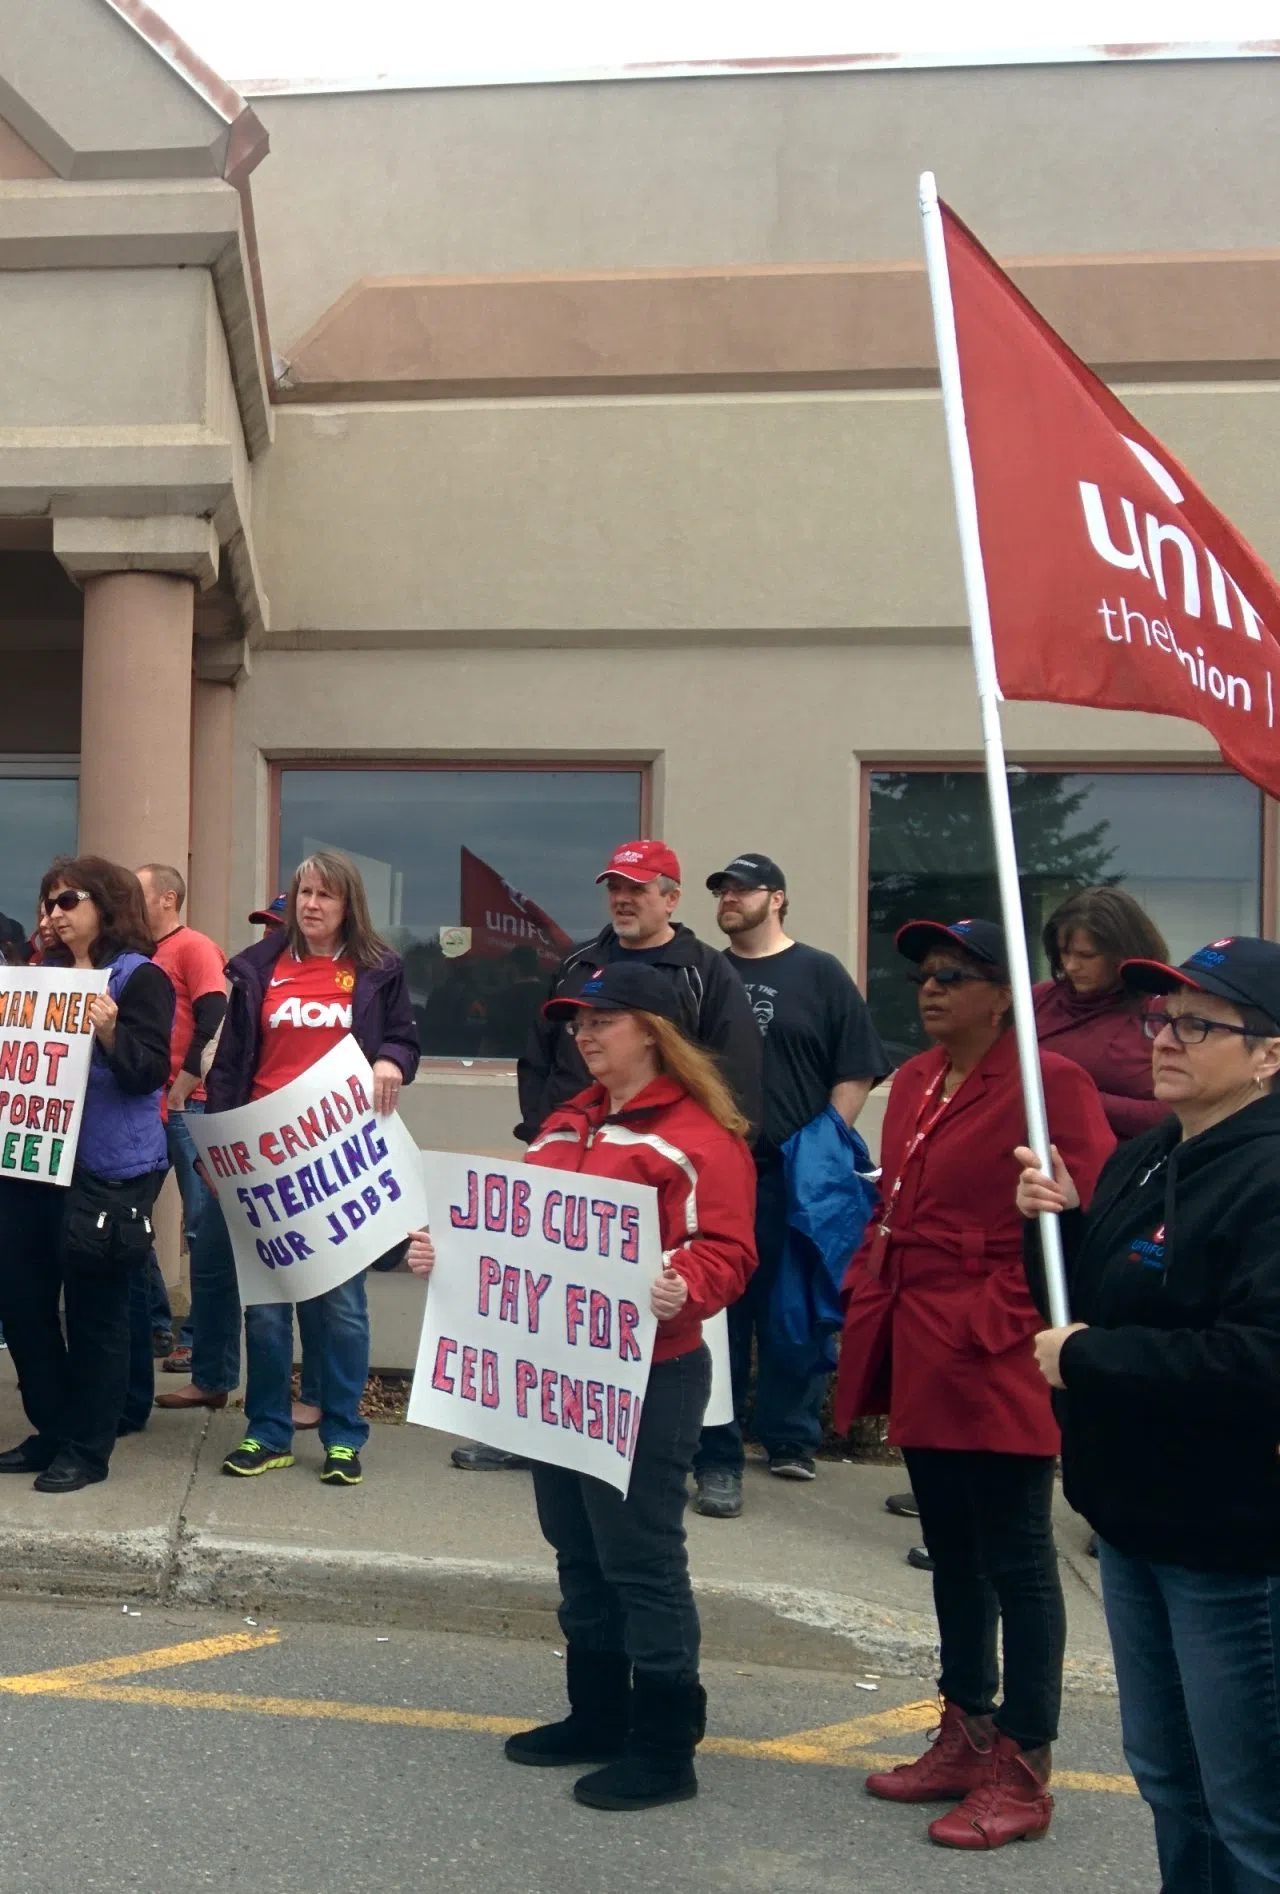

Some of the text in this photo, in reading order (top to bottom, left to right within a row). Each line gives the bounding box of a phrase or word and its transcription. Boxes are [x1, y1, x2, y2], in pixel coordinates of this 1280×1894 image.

[269, 997, 352, 1028] AON
[207, 1074, 372, 1178] AIR CANADA
[237, 1118, 389, 1228] STEALING
[255, 1168, 402, 1270] OUR JOBS
[449, 1169, 640, 1264] JOB CUTS
[478, 1255, 642, 1362] PAY FOR
[431, 1336, 500, 1409] CEO
